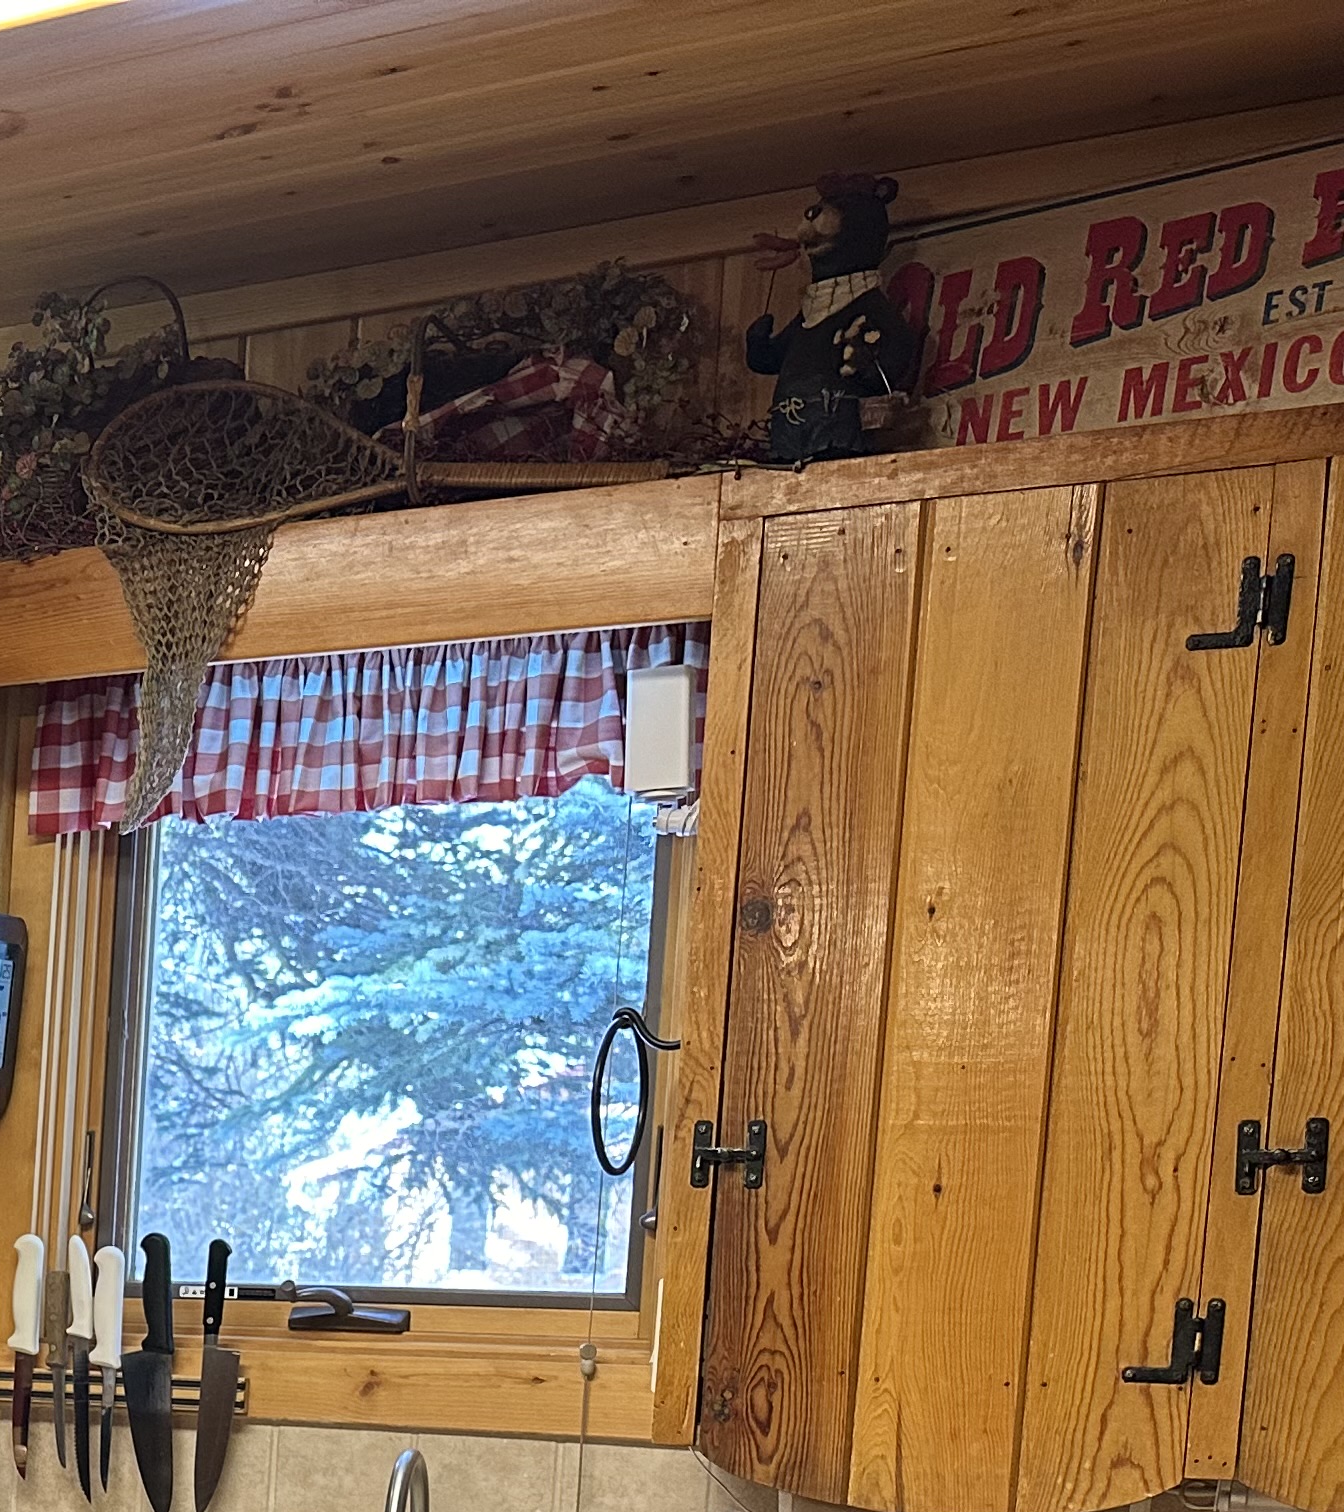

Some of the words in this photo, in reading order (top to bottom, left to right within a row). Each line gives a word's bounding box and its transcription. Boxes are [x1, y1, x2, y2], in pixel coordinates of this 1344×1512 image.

[1069, 201, 1275, 349] RED
[1262, 279, 1334, 327] EST
[956, 376, 1089, 447] NEW
